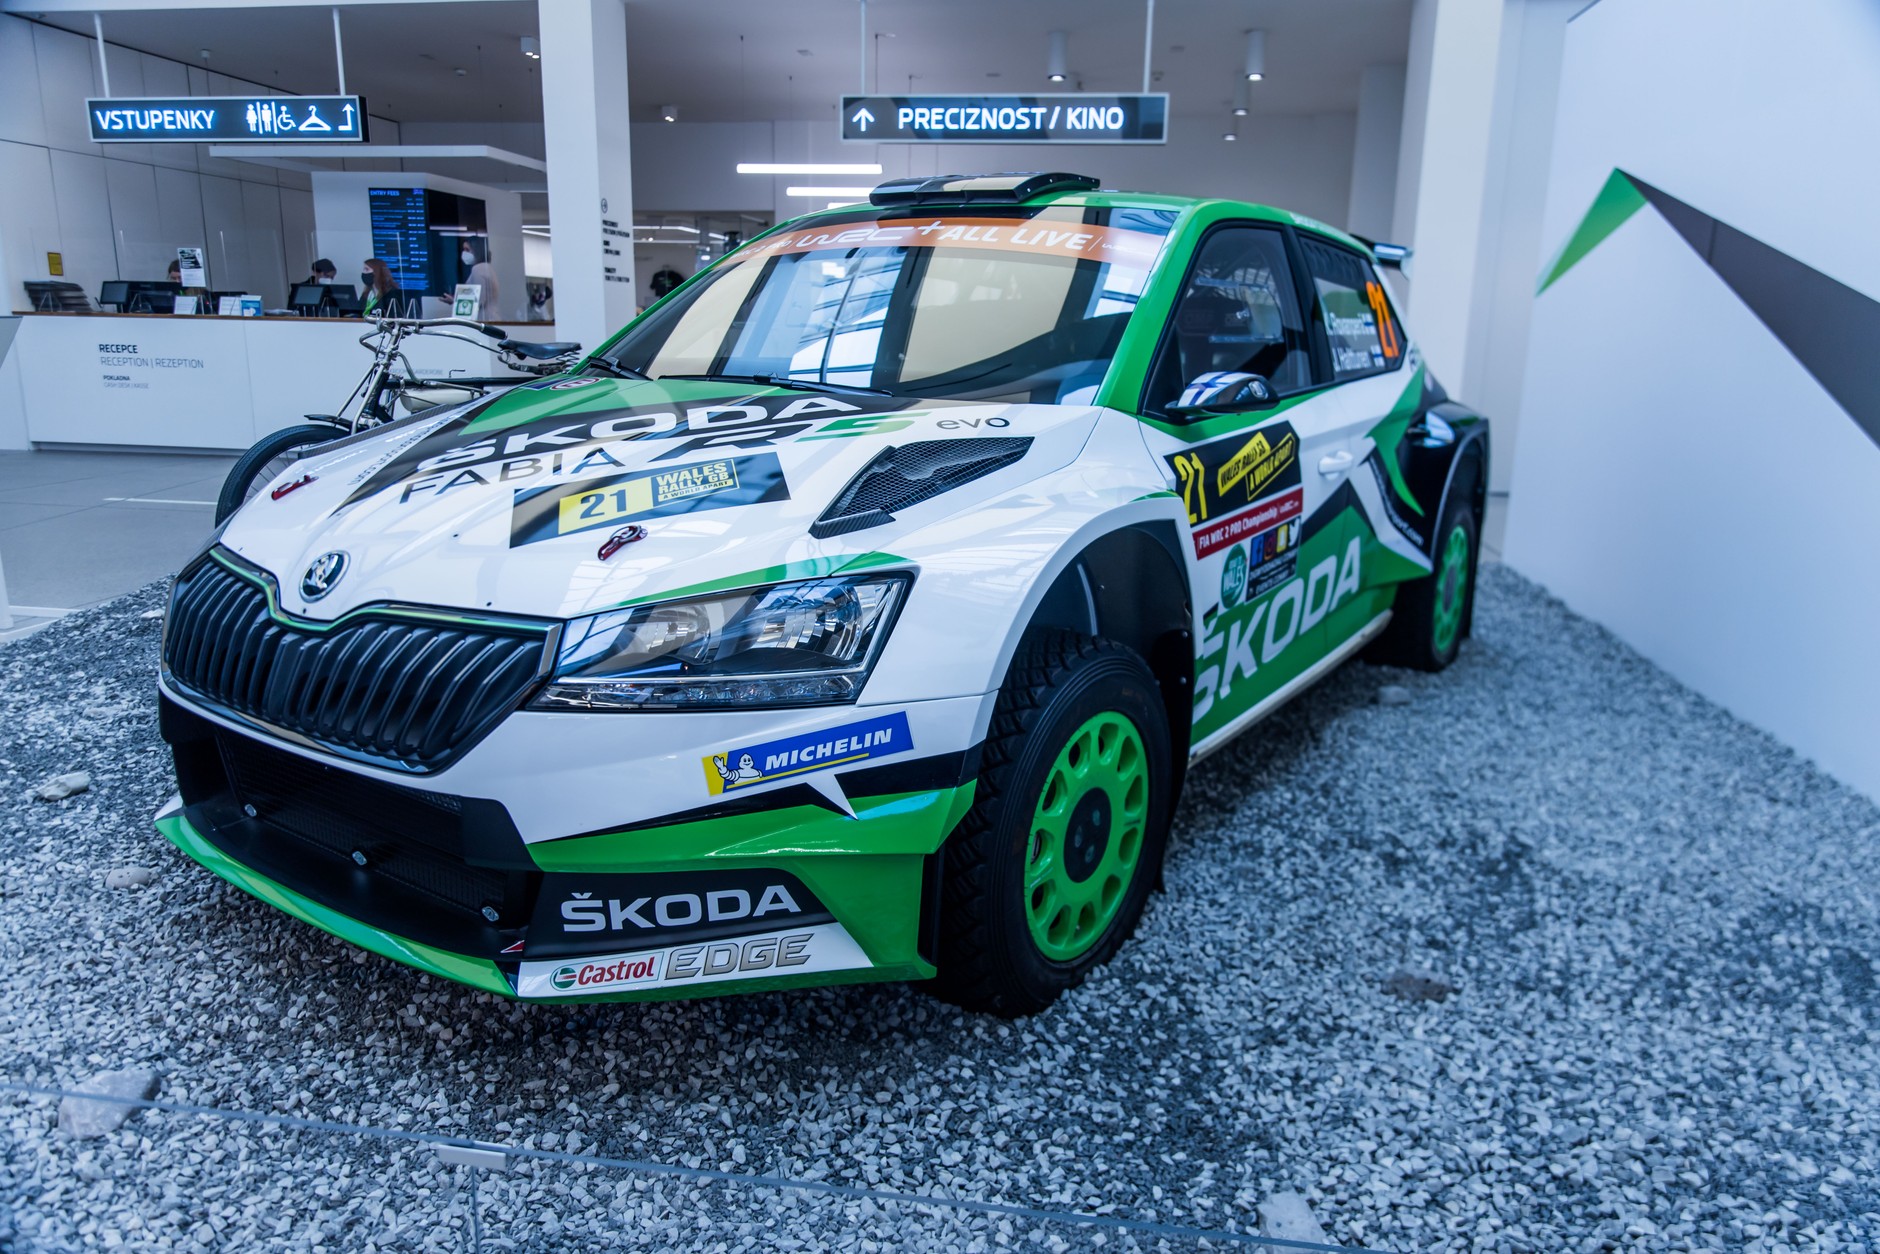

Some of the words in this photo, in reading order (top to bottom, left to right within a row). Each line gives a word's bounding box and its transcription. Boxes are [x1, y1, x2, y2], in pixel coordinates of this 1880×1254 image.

[95, 110, 215, 130] VSTUPENKY
[898, 107, 1047, 130] PRECIZNOST
[1066, 106, 1125, 130] KINO
[938, 224, 1000, 243] ALL
[1009, 229, 1095, 252] LIVE
[99, 344, 138, 354] RECEPCE
[100, 357, 149, 367] RECEPTION
[155, 358, 204, 369] REZEPTION
[399, 447, 626, 504] FABIA
[936, 417, 1010, 431] evo
[656, 462, 727, 486] WALES
[659, 474, 704, 495] RALLY
[708, 471, 730, 483] GB
[671, 486, 701, 498] WORLD
[702, 480, 729, 490] APART
[1174, 452, 1208, 525] 21
[580, 489, 627, 519] 21
[1199, 534, 1210, 550] FIA
[1210, 531, 1224, 547] WRC
[1224, 525, 1229, 539] 2
[1230, 520, 1242, 536] PRO
[1242, 505, 1278, 531] Championship
[1192, 535, 1361, 725] ŠKODA
[765, 727, 893, 771] MICHELIN
[561, 884, 802, 932] ŠKODA
[578, 956, 655, 986] Castrol
[664, 932, 815, 981] EDGE
